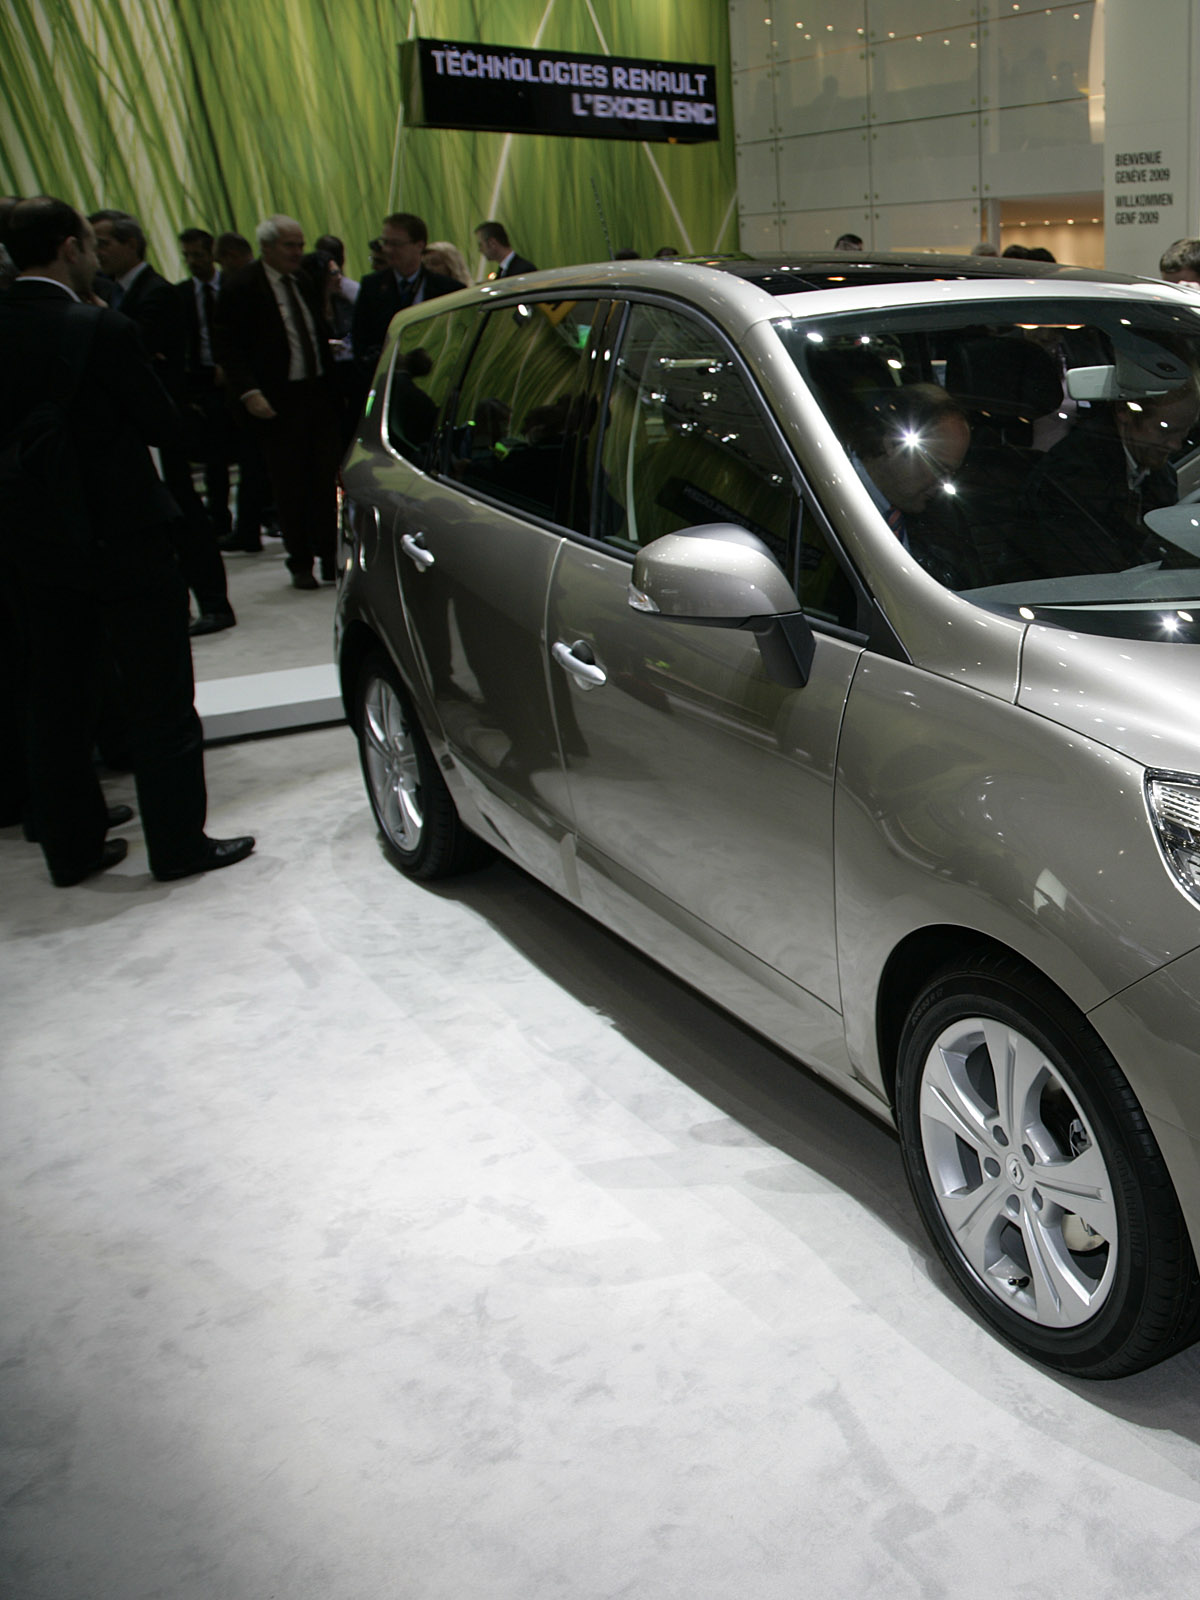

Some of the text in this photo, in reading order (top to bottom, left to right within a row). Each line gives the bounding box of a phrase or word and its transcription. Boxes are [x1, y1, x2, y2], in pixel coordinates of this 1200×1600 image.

[431, 50, 707, 97] TECHNOLOGIES RENAULT
[572, 93, 716, 126] L'EXCELLENC
[1115, 150, 1162, 167] BIENVENUE
[1149, 168, 1170, 182] 2009
[1115, 193, 1173, 208] WILLKOMMEN
[1115, 211, 1159, 225] GENF 2009
